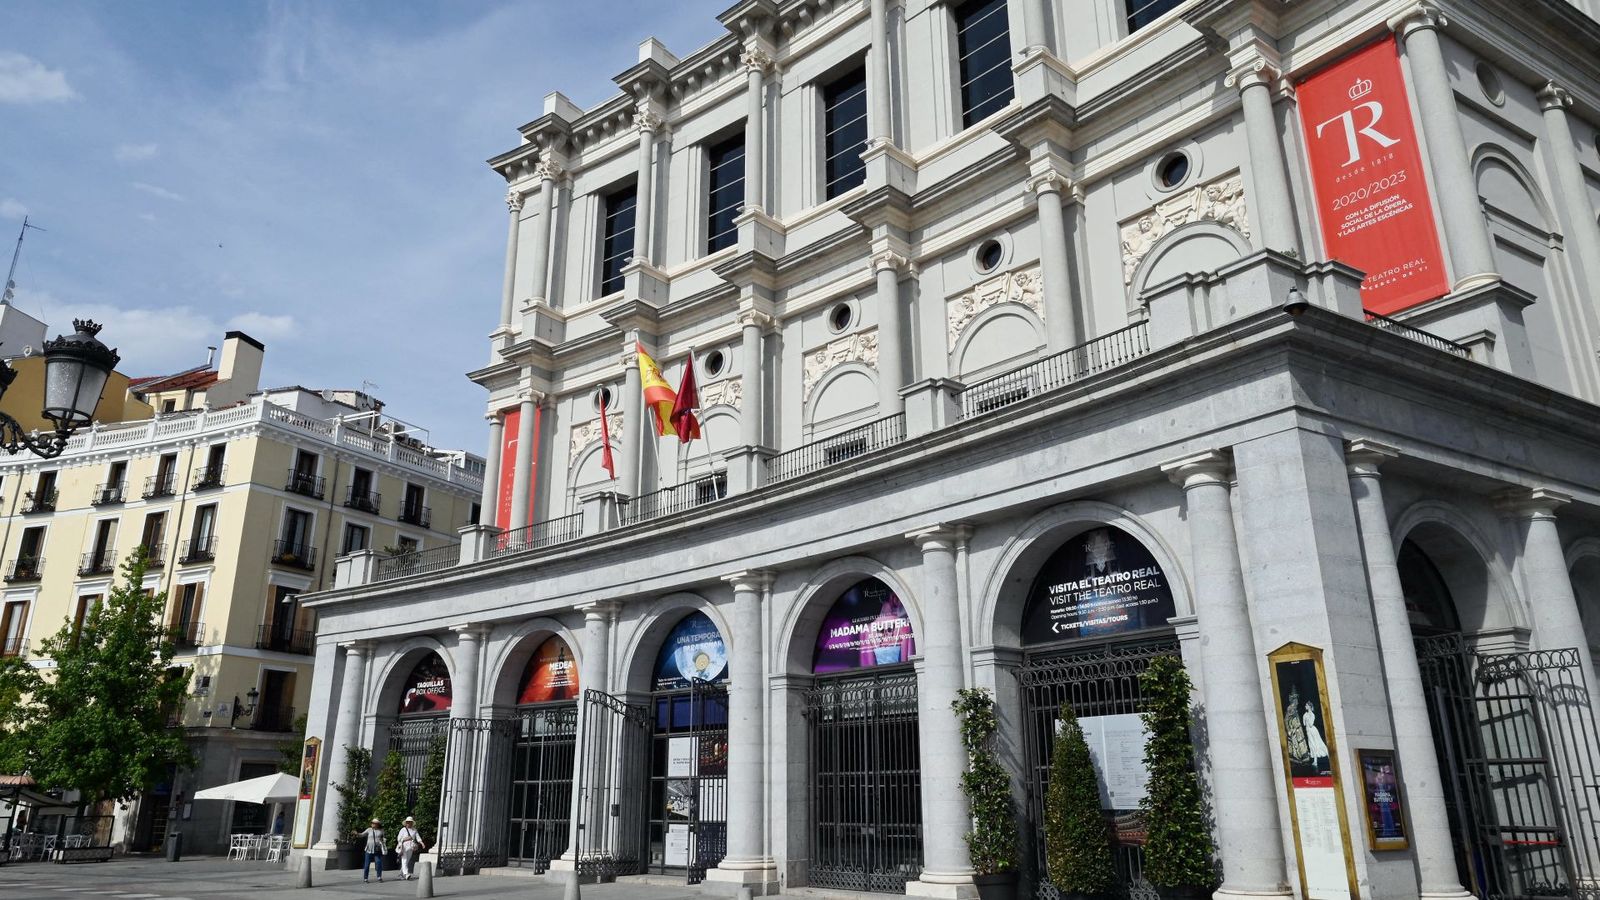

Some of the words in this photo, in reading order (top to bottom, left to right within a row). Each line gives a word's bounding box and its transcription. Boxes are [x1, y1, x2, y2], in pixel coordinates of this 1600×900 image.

[1332, 170, 1407, 211] 2020/2023
[1341, 217, 1363, 230] SOCIAL
[1364, 212, 1374, 220] DE
[1374, 208, 1383, 216] LA
[1384, 198, 1407, 212] ÓPERA
[1343, 226, 1356, 236] LAS
[1356, 218, 1377, 231] ARTES
[1377, 203, 1413, 222] ESCÉNICAS
[1345, 211, 1359, 221] CON
[1360, 207, 1369, 215] LA
[1369, 194, 1400, 211] DIFUSIÓN
[1368, 267, 1400, 283] TEATRO
[1403, 258, 1426, 271] REAL
[1049, 581, 1079, 595] VISITA
[1079, 577, 1092, 589] EL
[1092, 571, 1131, 587] TEATRO
[1131, 566, 1160, 580] REAL
[1049, 593, 1072, 606] VISIT
[1074, 588, 1092, 602] THE
[1093, 583, 1132, 598] TEATRO
[1133, 578, 1162, 592] REAL
[830, 624, 870, 638] MADAMA
[1060, 614, 1129, 630] TICKETS/VISITAS/TOURS
[549, 660, 573, 671] MEDEA
[417, 679, 444, 689] TAQUILLAS
